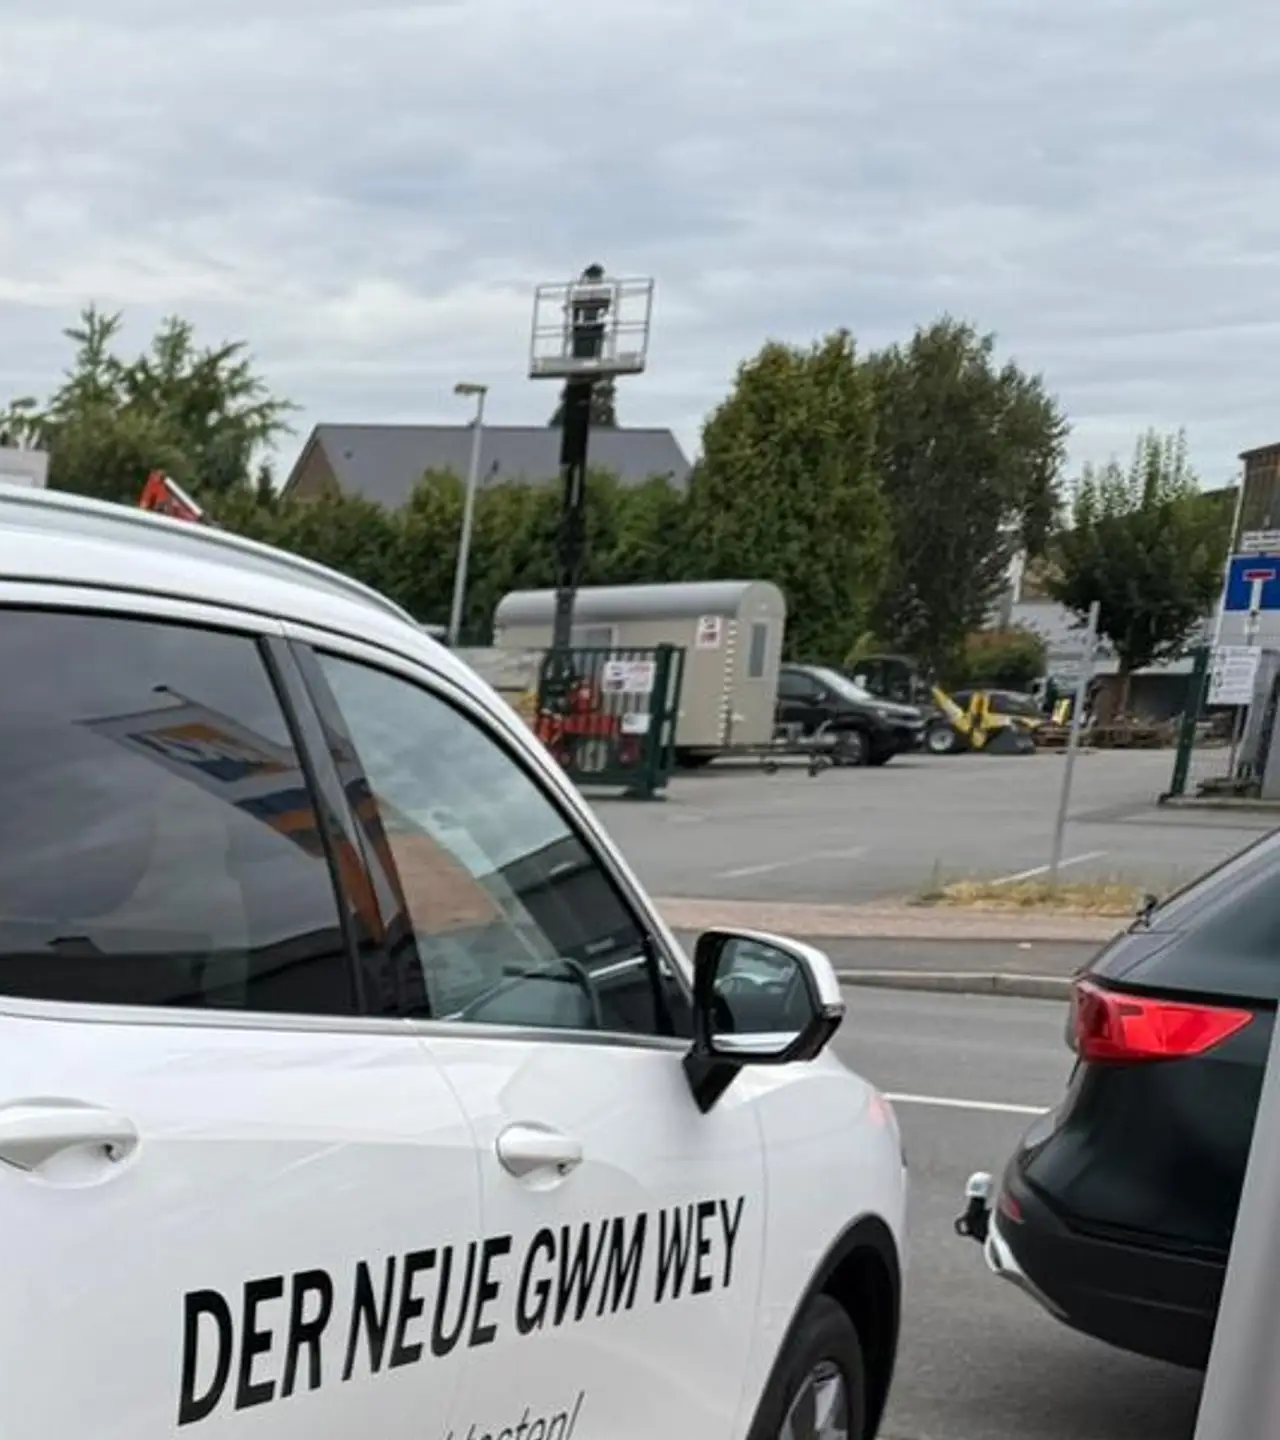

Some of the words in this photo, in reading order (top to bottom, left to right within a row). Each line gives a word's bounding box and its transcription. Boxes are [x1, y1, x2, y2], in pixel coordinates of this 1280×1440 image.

[177, 1269, 334, 1426] DER
[341, 1235, 512, 1382] NEUE
[515, 1213, 647, 1336] GWM
[654, 1195, 744, 1303] WEY
